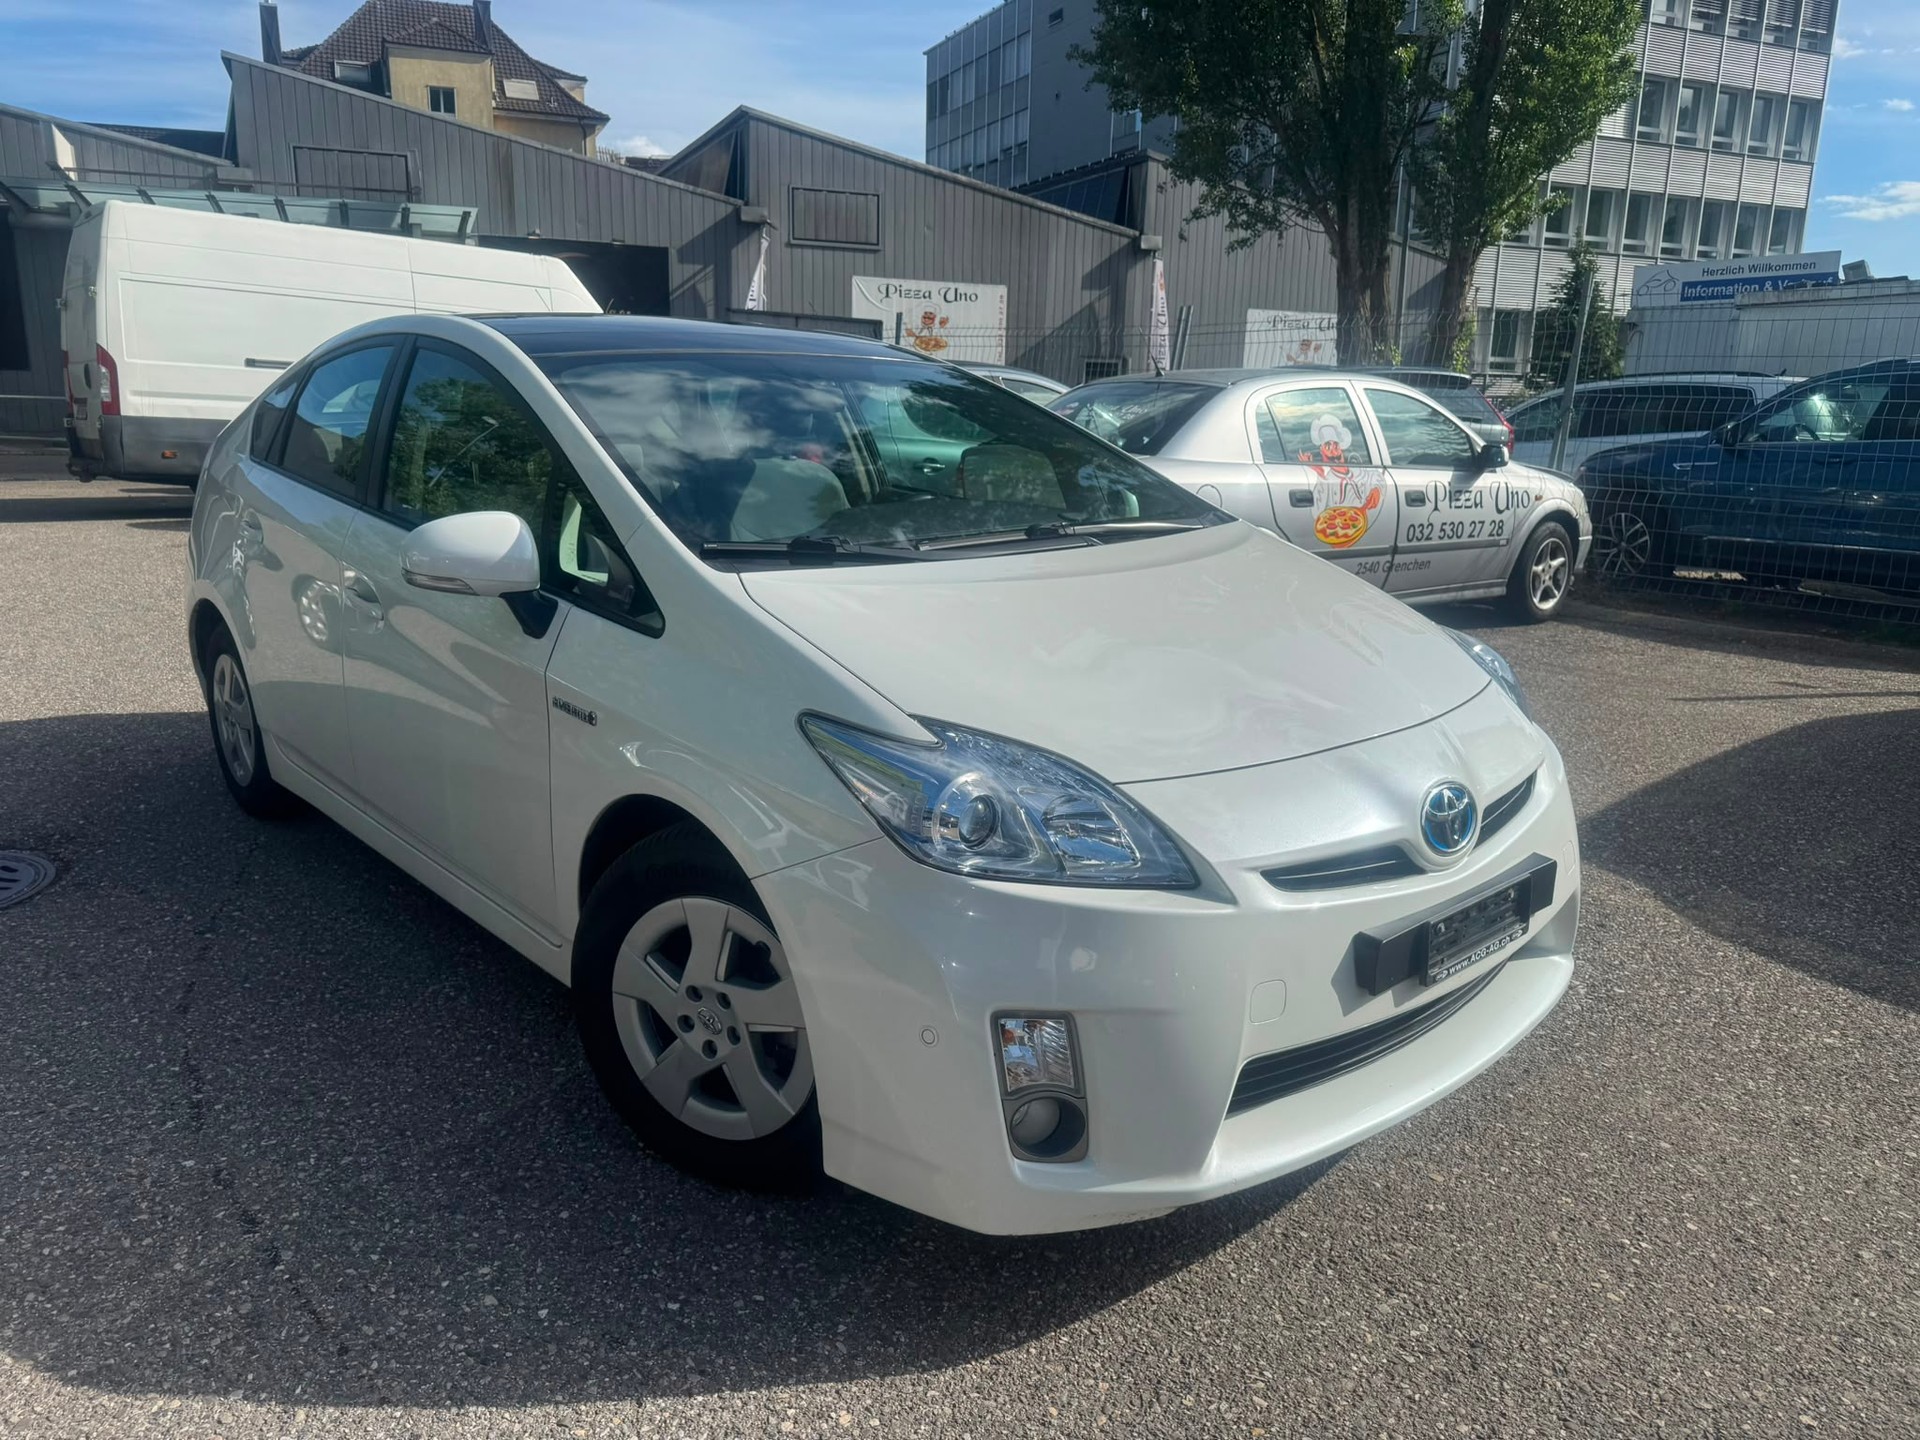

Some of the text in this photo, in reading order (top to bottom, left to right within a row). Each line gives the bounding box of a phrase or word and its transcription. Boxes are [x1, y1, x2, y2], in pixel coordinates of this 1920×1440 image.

[1702, 260, 1817, 277] Herzlich Willkommen
[877, 283, 979, 304] Pizza Uno
[1684, 282, 1760, 298] Information
[1425, 480, 1531, 522] Pizza Uno
[1406, 519, 1505, 543] 032 530 27 28
[1356, 558, 1431, 576] 2540 Grenchen
[1448, 936, 1511, 975] www.ACG-AG.ch
